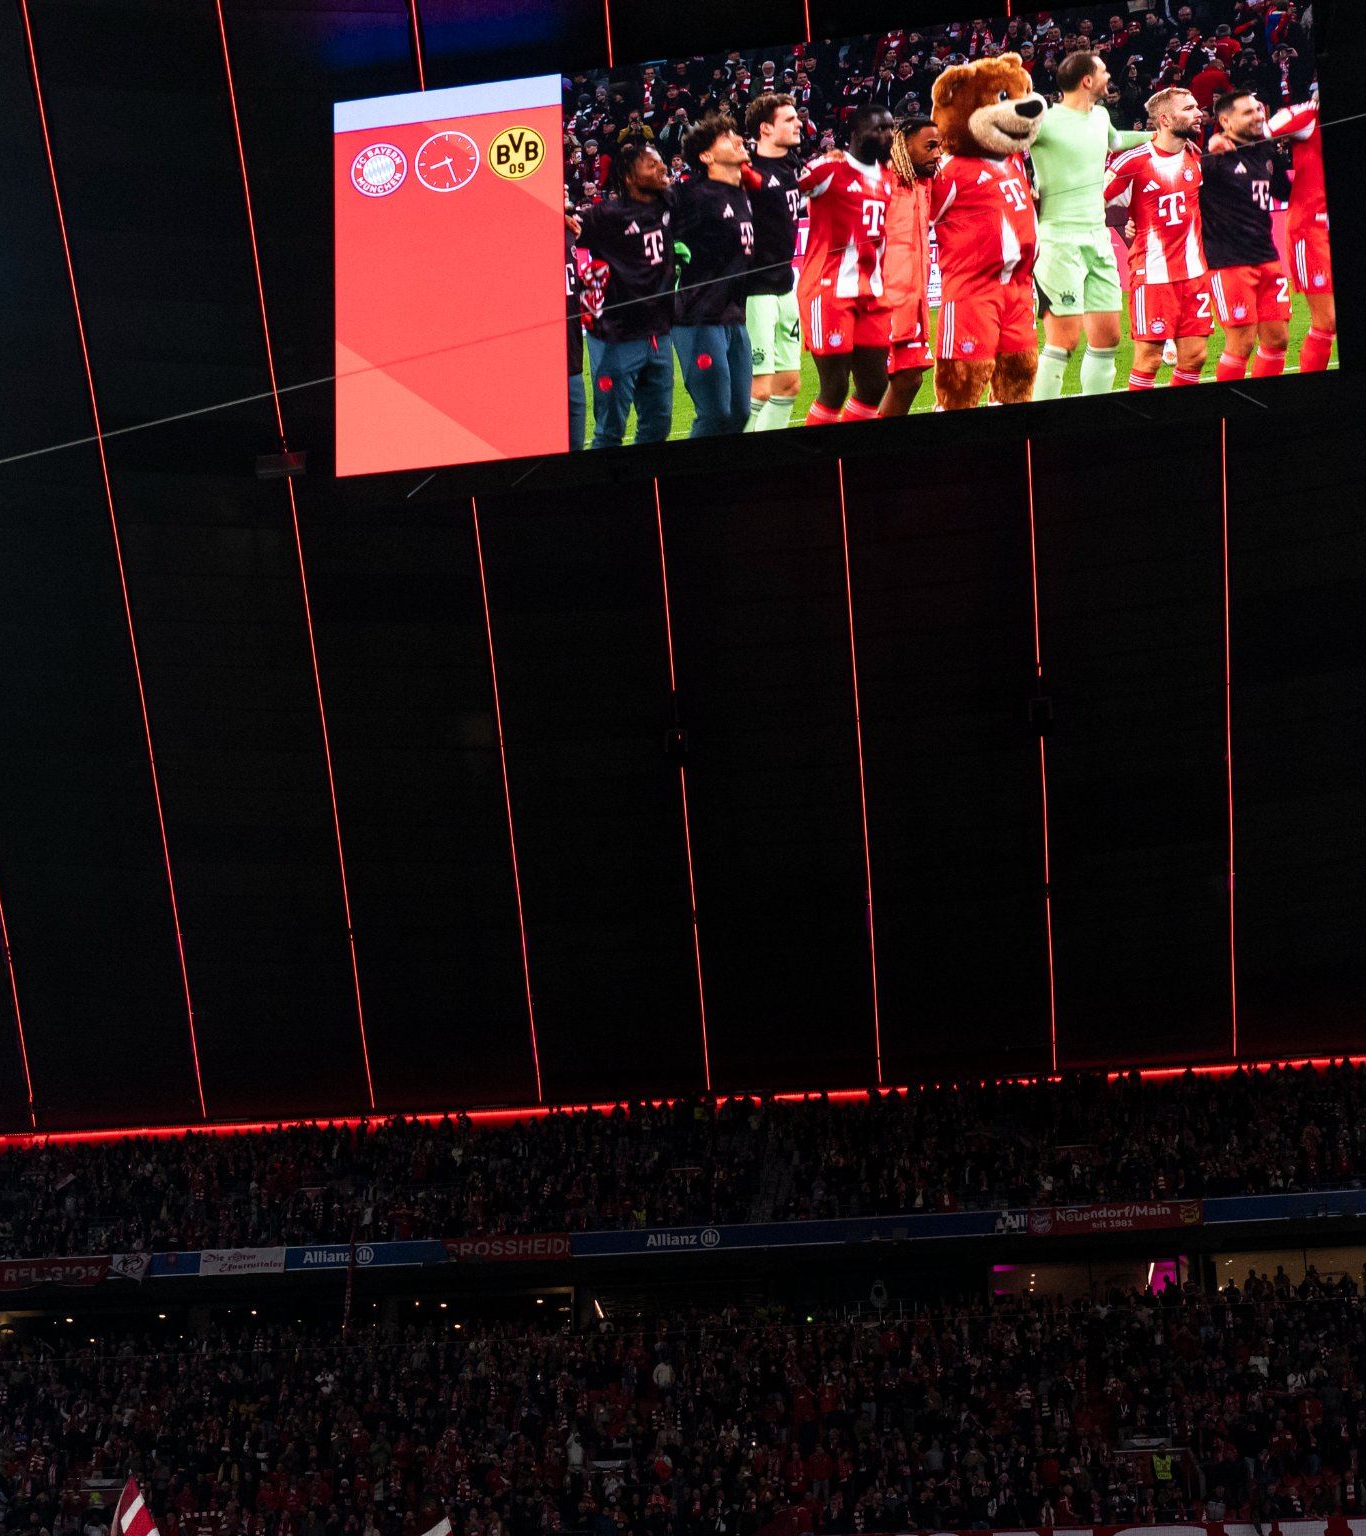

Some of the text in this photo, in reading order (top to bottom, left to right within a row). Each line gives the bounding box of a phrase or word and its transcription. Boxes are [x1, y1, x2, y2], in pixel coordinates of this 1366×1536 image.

[368, 147, 403, 165] BAYERN
[497, 132, 539, 165] BVB
[510, 163, 525, 174] 09
[357, 172, 403, 194] MÜNCHEN
[1158, 192, 1186, 226] T
[1055, 1205, 1171, 1223] Neuendorf/Main
[646, 1233, 698, 1247] Allianz
[302, 1251, 350, 1265] Allianz
